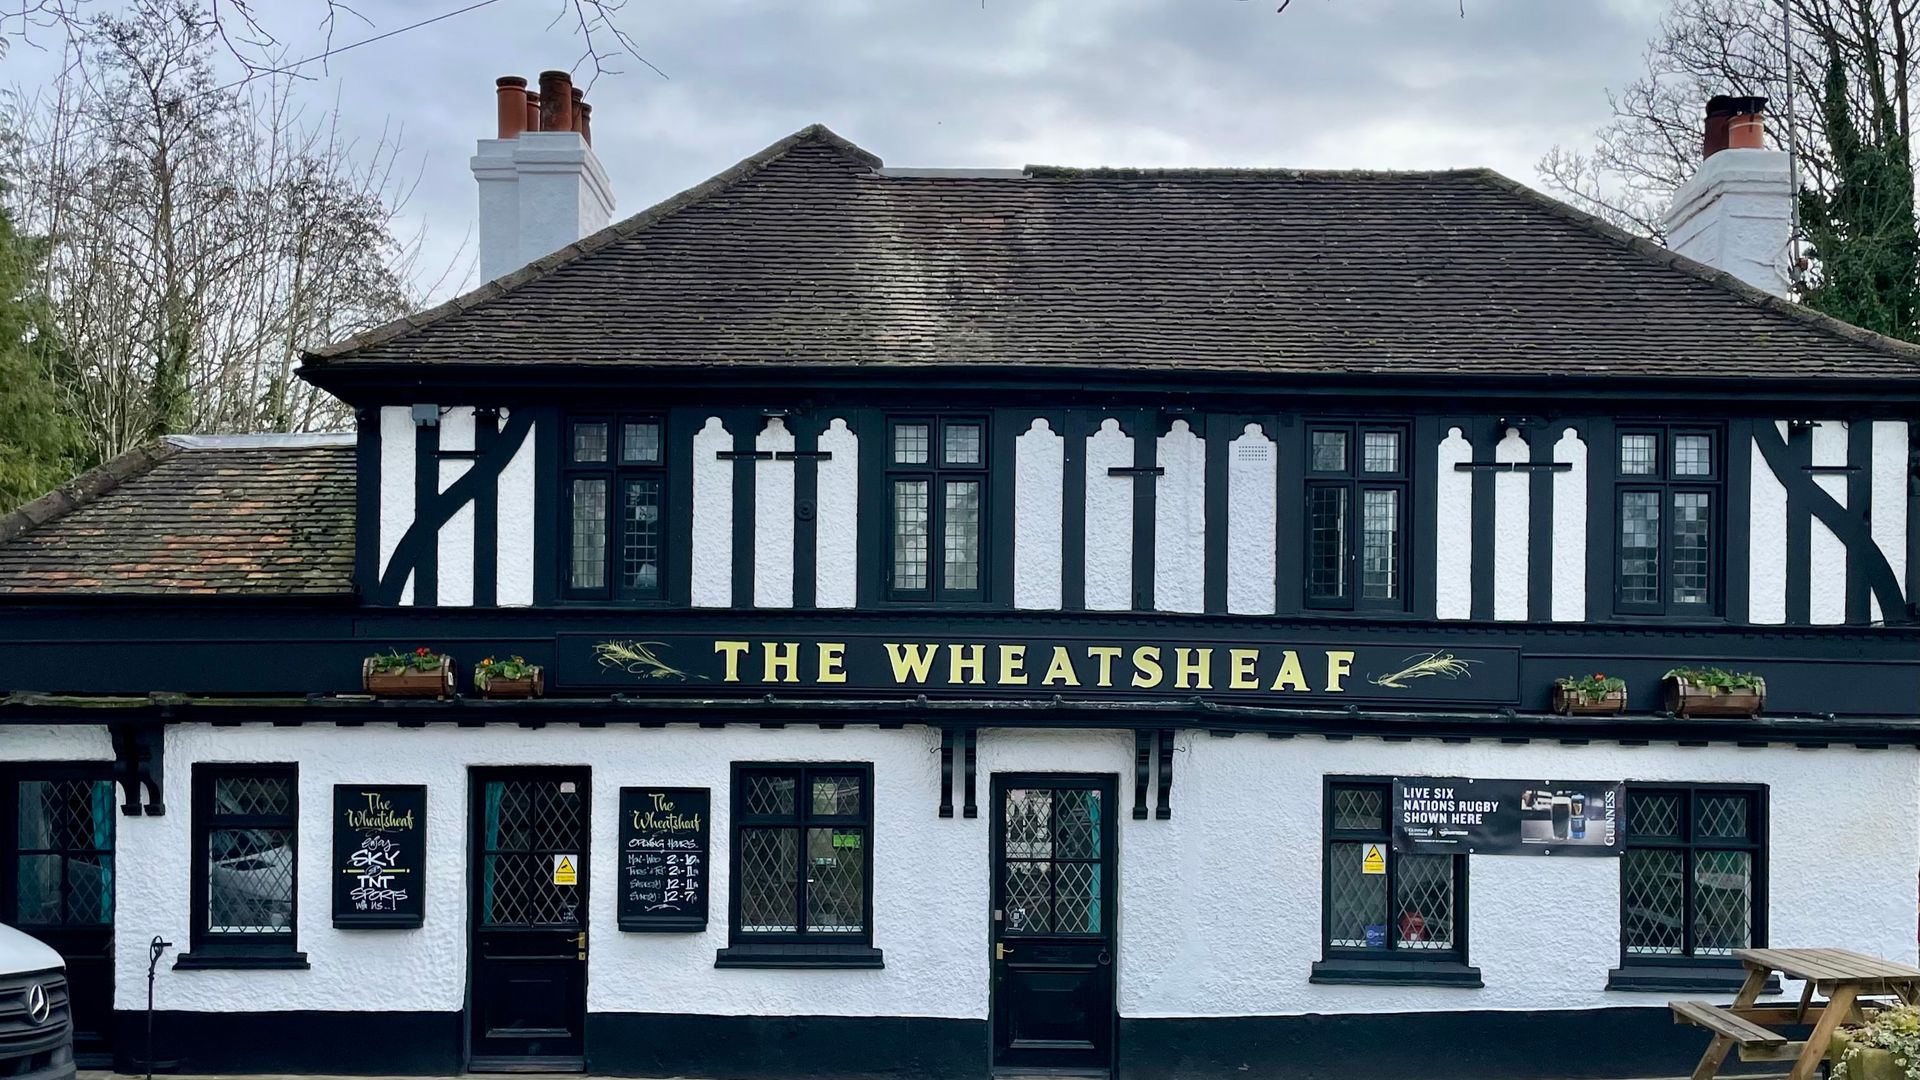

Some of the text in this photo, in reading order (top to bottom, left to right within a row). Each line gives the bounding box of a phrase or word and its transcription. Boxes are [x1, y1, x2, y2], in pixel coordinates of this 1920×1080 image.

[714, 641, 1355, 692] THE WHEATSHEAF
[361, 792, 392, 814] The
[648, 793, 675, 812] The
[1403, 787, 1454, 799] LIVE SIX
[1403, 800, 1499, 812] NATIONS RUGBY
[344, 809, 414, 830] Wheatsheaf
[633, 810, 701, 833] Wheatsheaf
[1403, 812, 1483, 825] SHOWN HERE
[1604, 791, 1615, 847] GUINNESS
[347, 849, 400, 867] SKY
[357, 875, 395, 888] TNT
[350, 888, 408, 911] SPORTS
